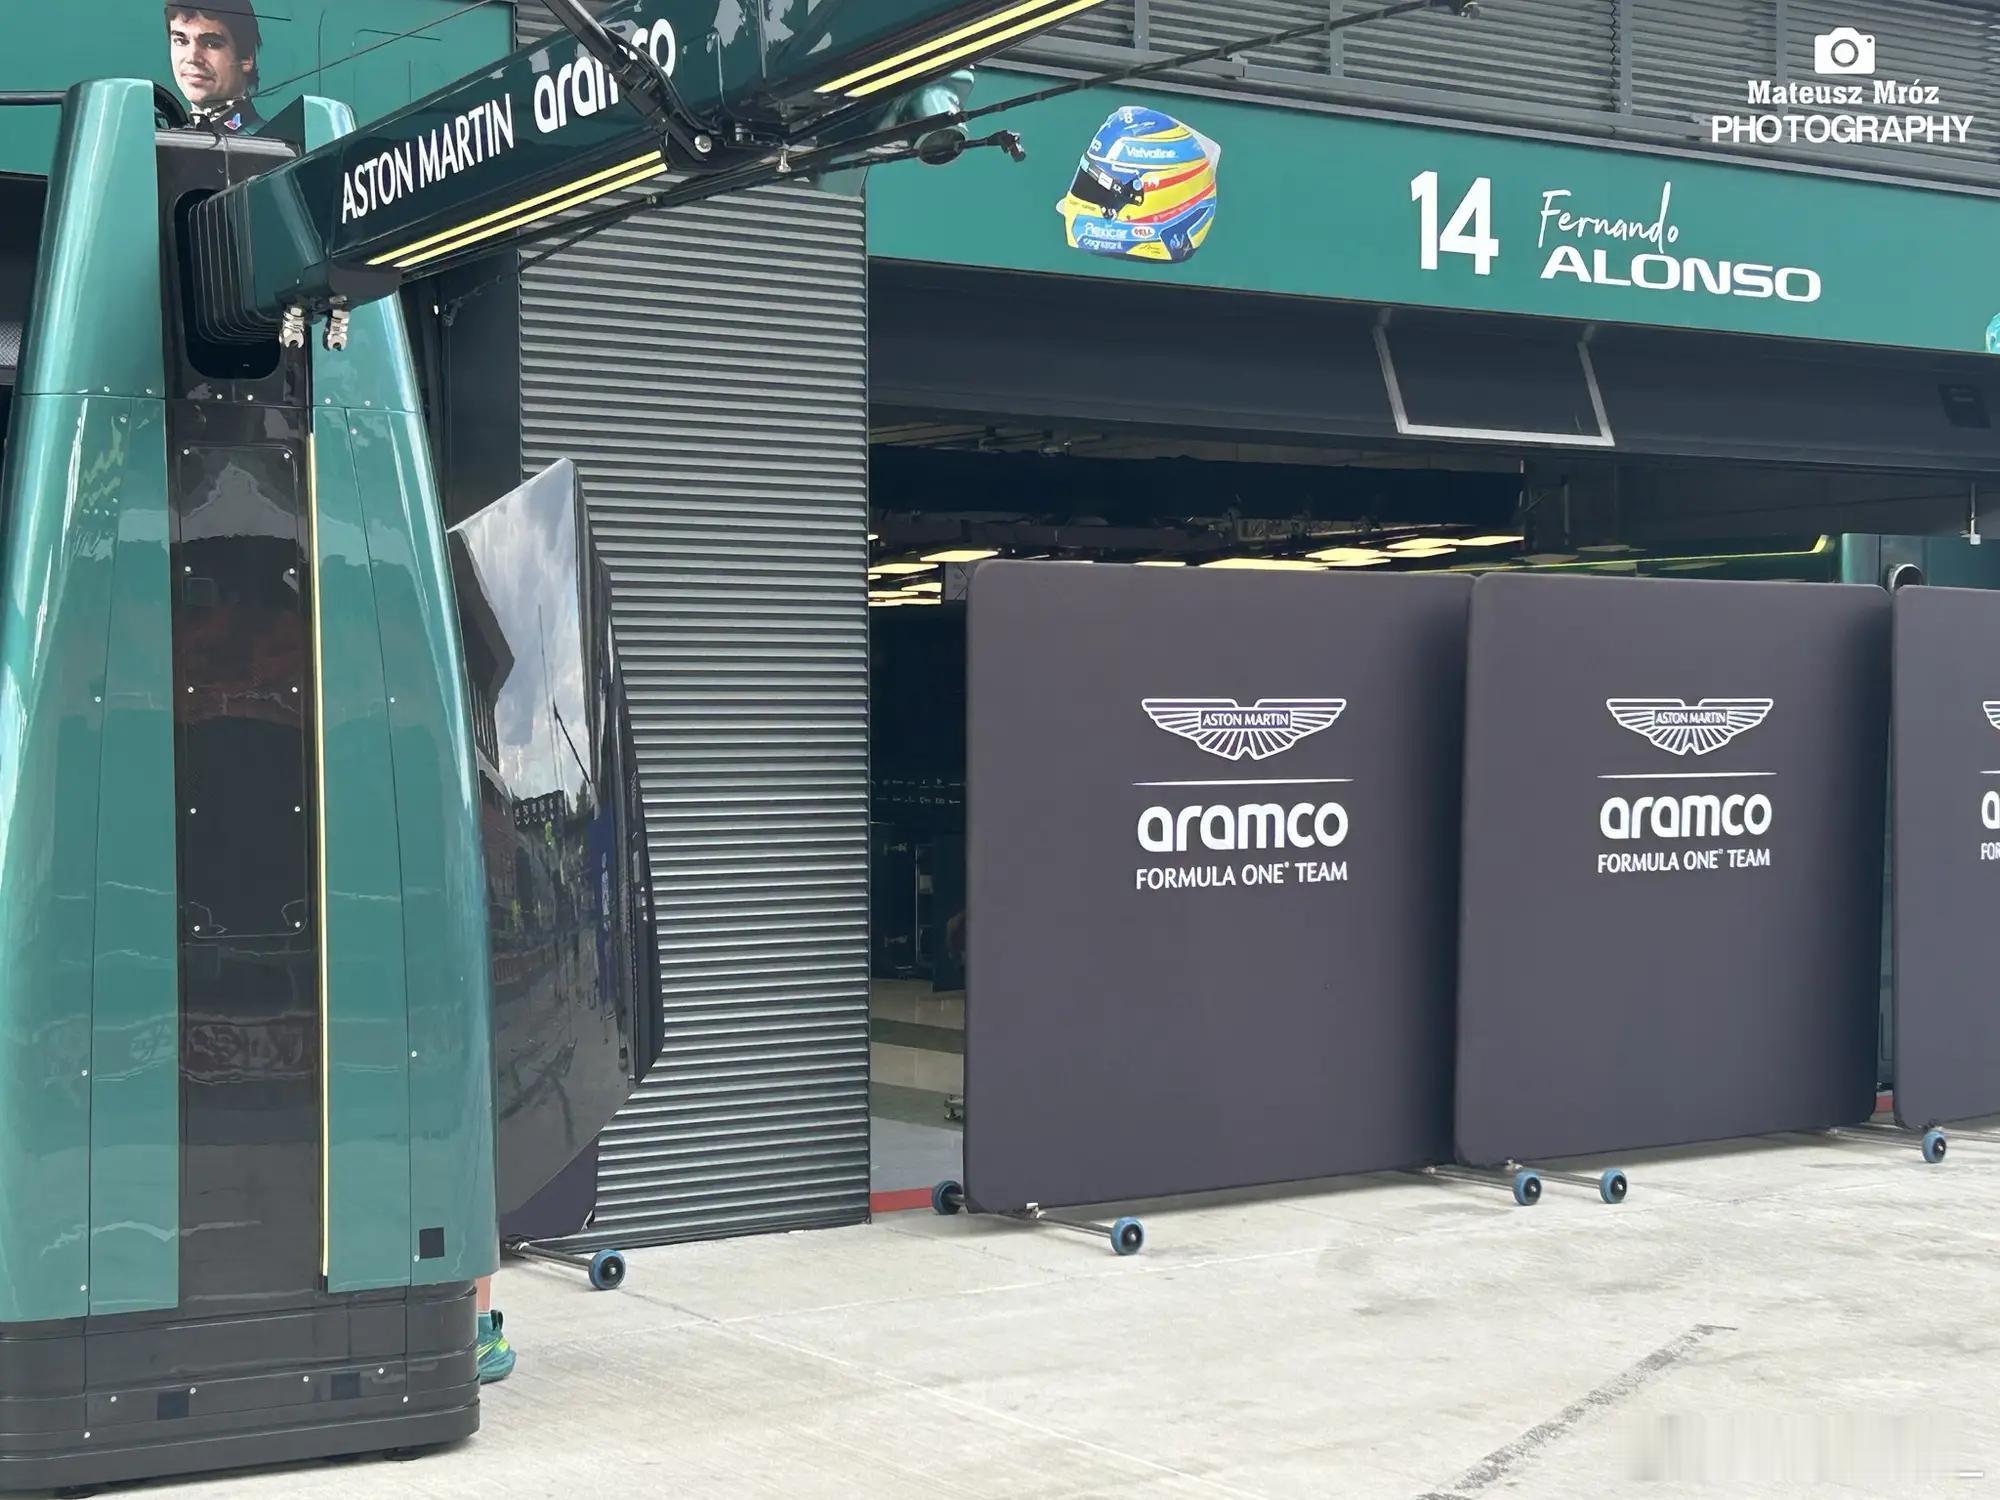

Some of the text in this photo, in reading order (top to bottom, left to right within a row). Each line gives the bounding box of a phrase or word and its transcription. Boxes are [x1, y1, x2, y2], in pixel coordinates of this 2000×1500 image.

[342, 141, 414, 224] ASTON
[418, 93, 514, 189] MARTIN
[1410, 170, 1499, 275] 14
[1538, 181, 1680, 253] Fernando
[1539, 245, 1822, 303] ALONSO
[1202, 712, 1290, 727] ASTON MARTIN
[1655, 711, 1727, 725] ASTON MARTIN
[1137, 801, 1350, 853] aramco
[1599, 793, 1773, 840] aramco
[1136, 866, 1237, 890] FORMULA
[1294, 860, 1349, 883] TEAM
[1597, 851, 1680, 874] FORMULA
[1727, 848, 1771, 868] TEAM
